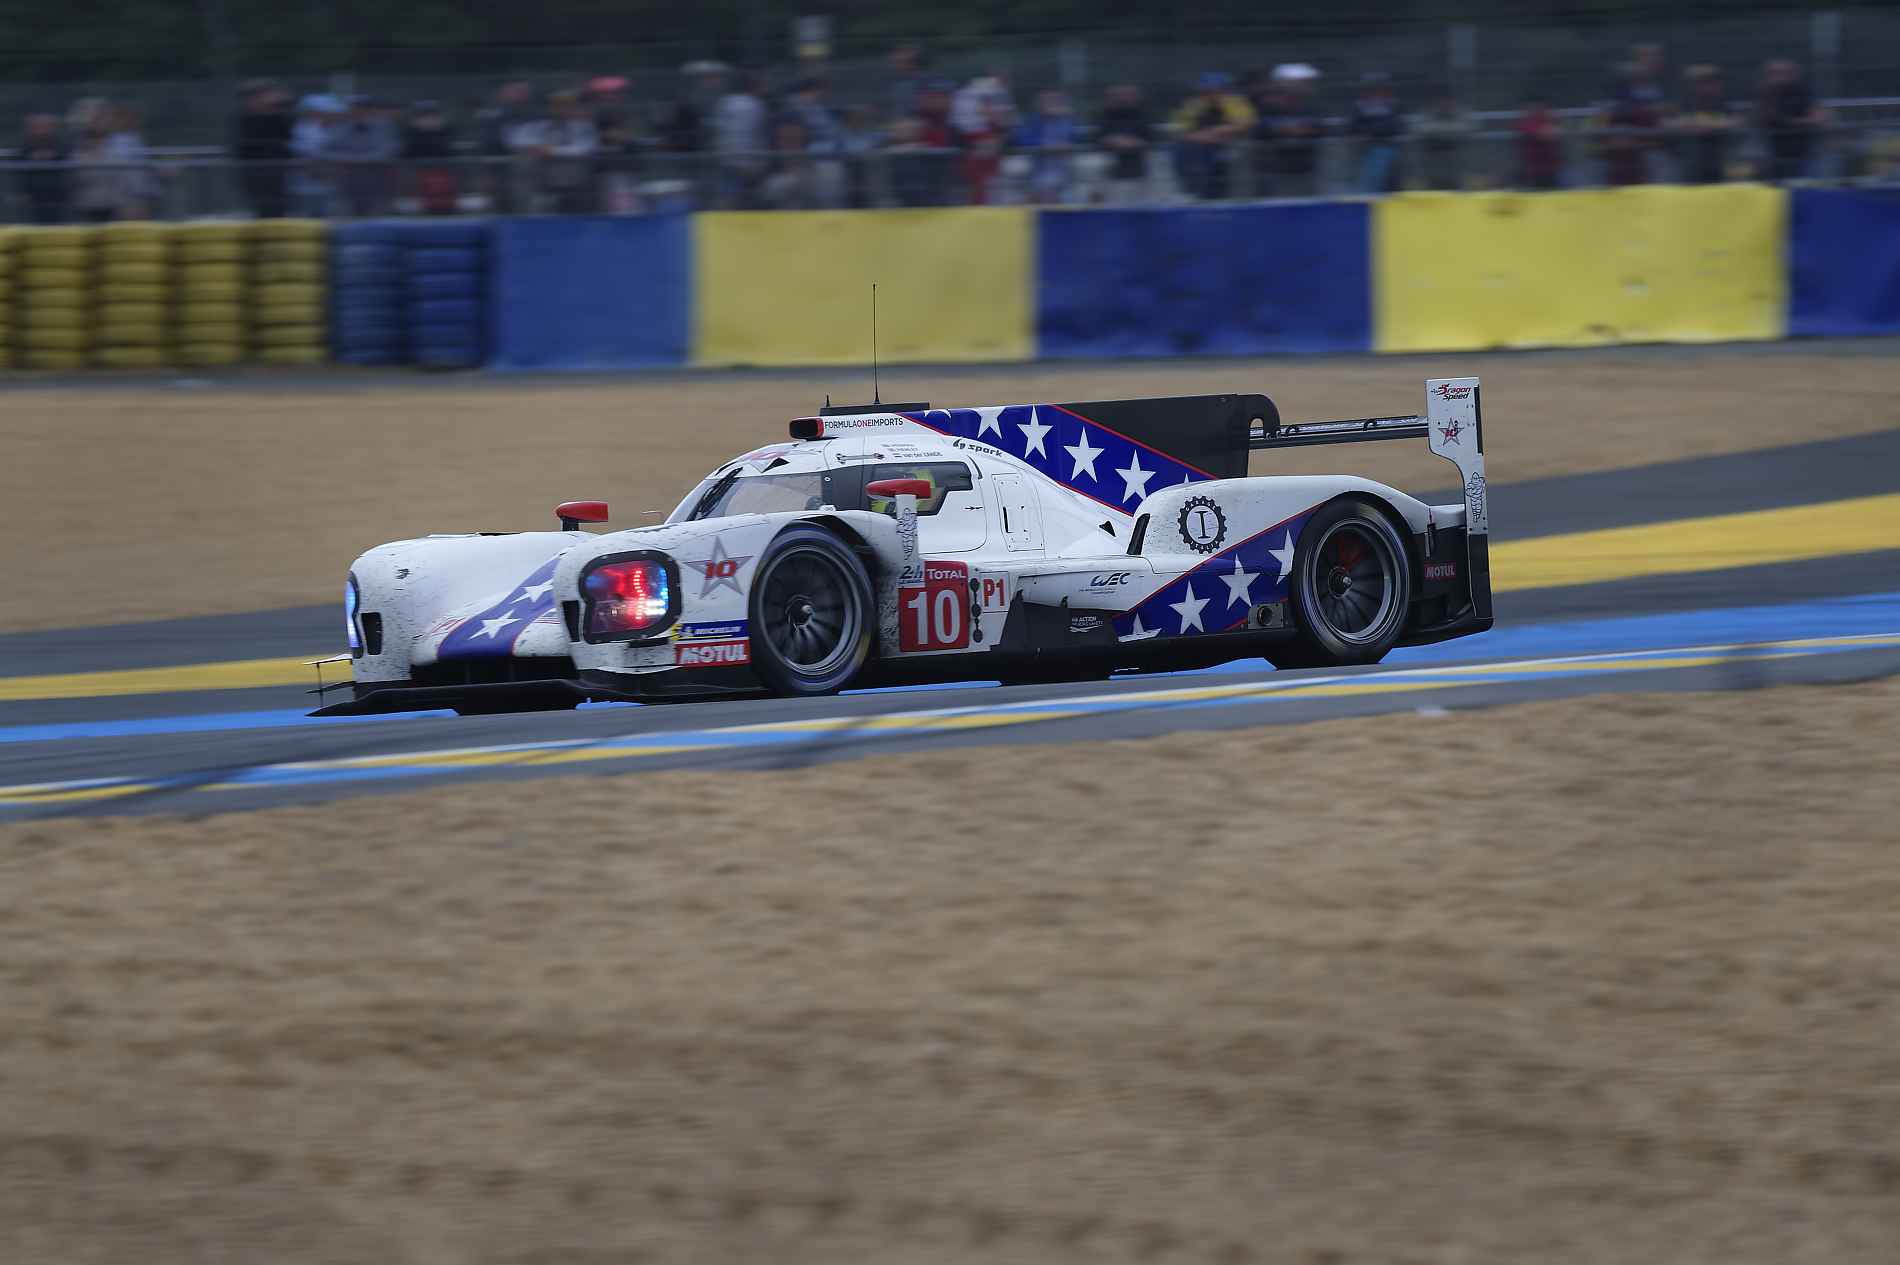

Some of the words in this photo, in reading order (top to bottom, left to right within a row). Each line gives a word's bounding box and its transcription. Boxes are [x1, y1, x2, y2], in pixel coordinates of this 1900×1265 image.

[967, 443, 1003, 458] spark
[705, 559, 737, 579] 10
[927, 568, 967, 580] TOTAL
[1425, 565, 1456, 577] MOTUL
[1090, 572, 1131, 586] WEC
[983, 578, 1005, 608] P1
[907, 589, 961, 645] 10
[680, 644, 748, 664] MOTUL
